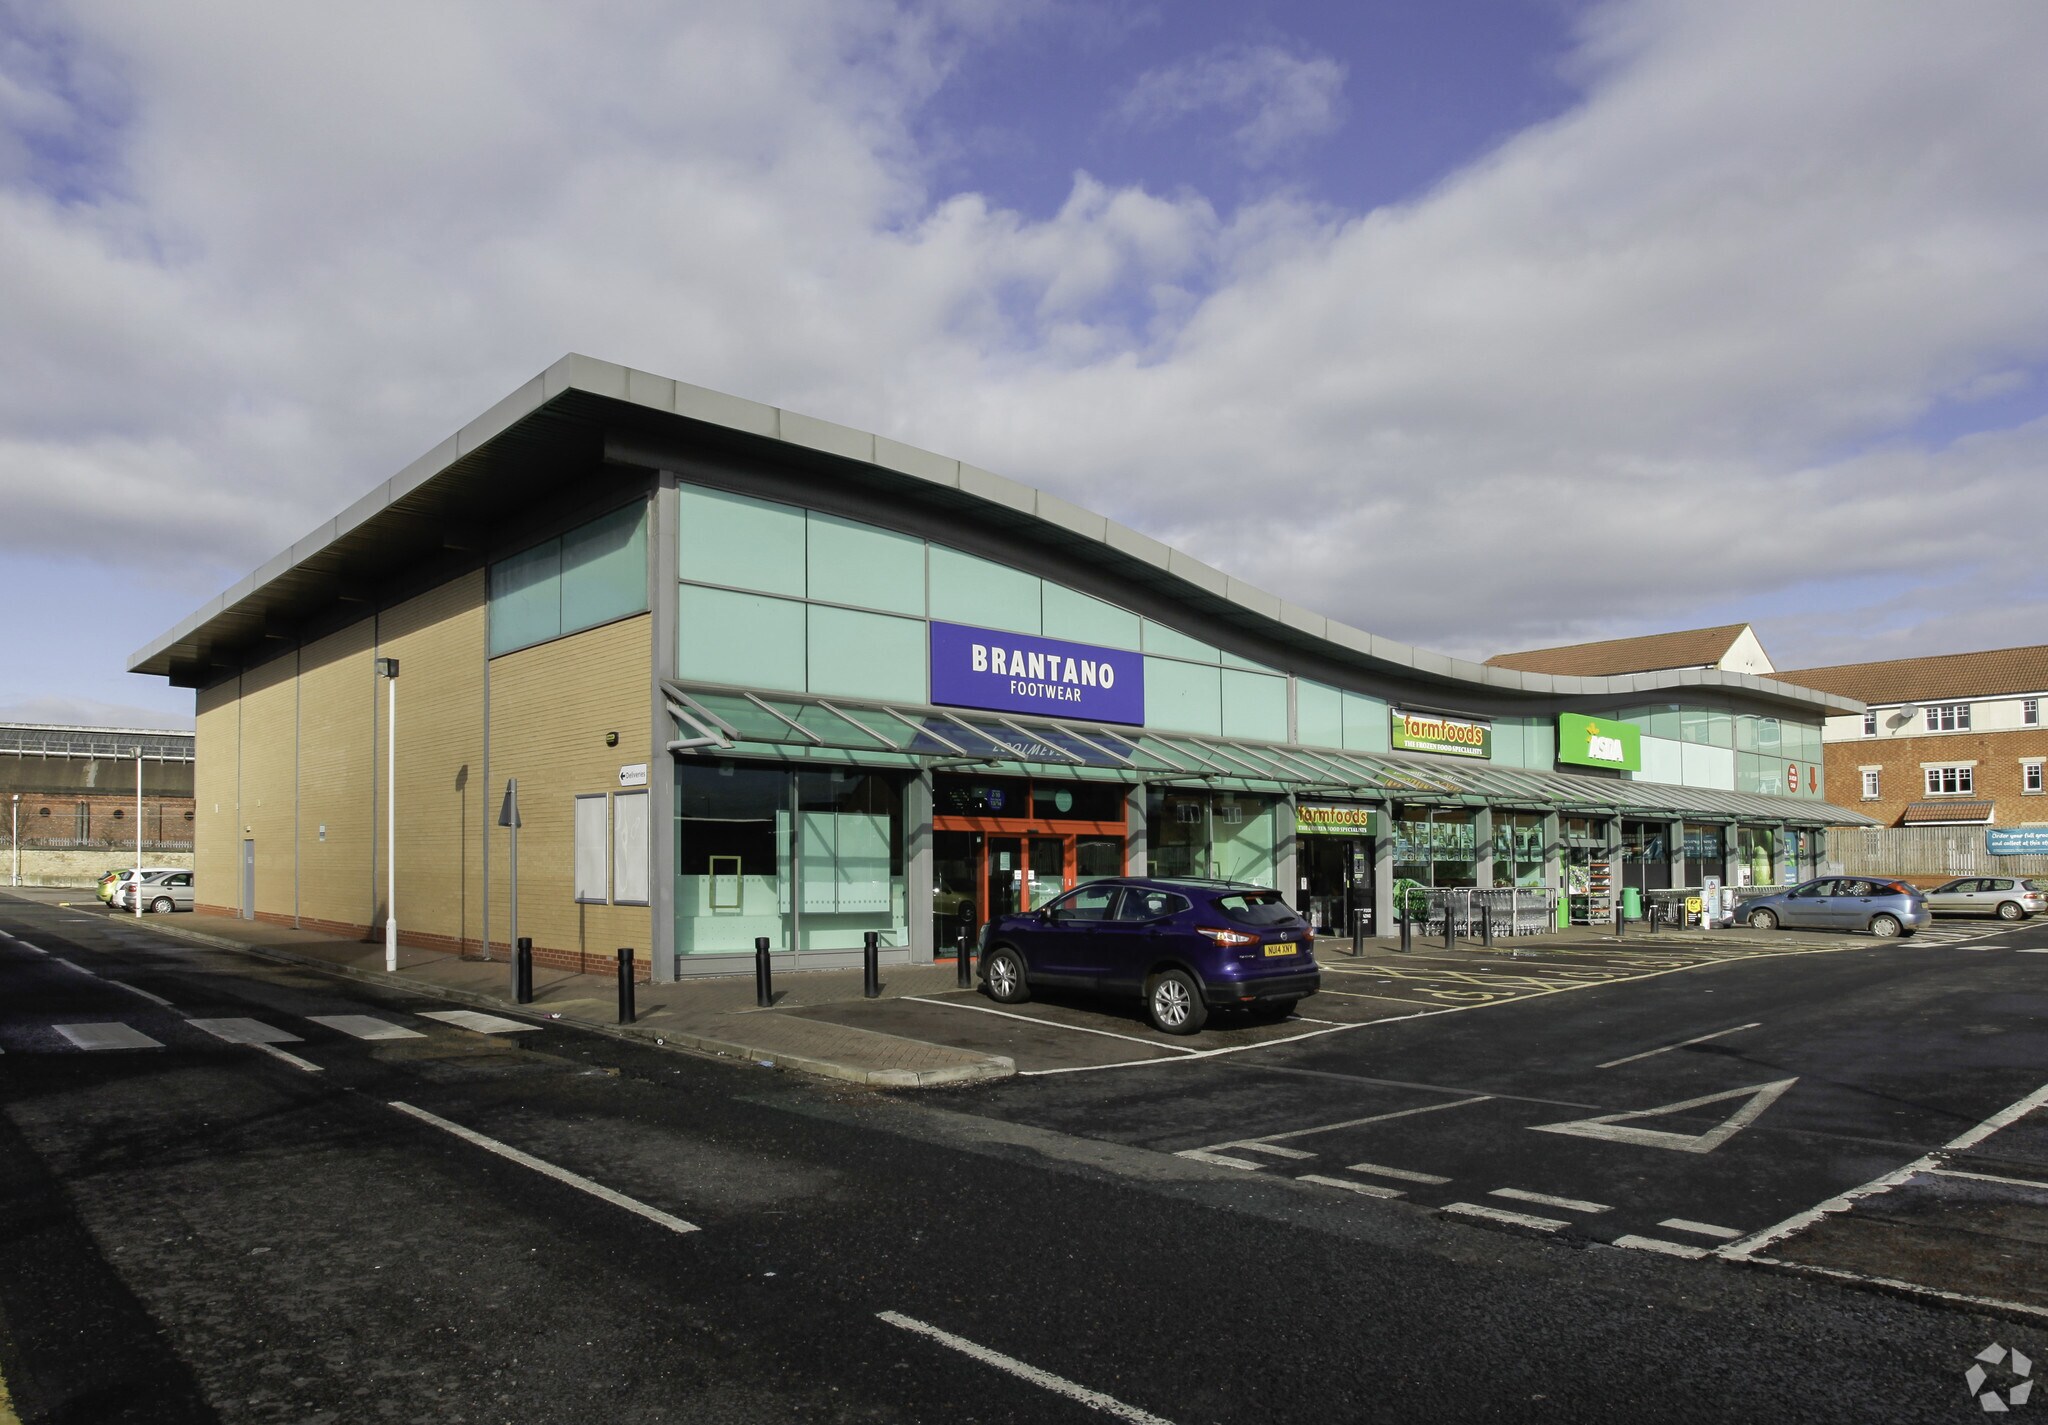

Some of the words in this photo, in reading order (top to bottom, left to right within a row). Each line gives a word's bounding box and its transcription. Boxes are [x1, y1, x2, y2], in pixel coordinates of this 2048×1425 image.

[972, 644, 1115, 689] BRANTANO
[1010, 680, 1082, 702] FOOTWEAR
[1404, 714, 1483, 745] farmfoods
[1404, 740, 1416, 748] THE
[1416, 741, 1437, 750] FROZEN
[1437, 743, 1453, 752] FOOD
[1452, 745, 1483, 755] SPECIALISTS
[1588, 735, 1624, 762] ASDA
[625, 771, 646, 779] Deliveries
[1298, 804, 1368, 826] farmfoods
[1282, 944, 1293, 953] XNY
